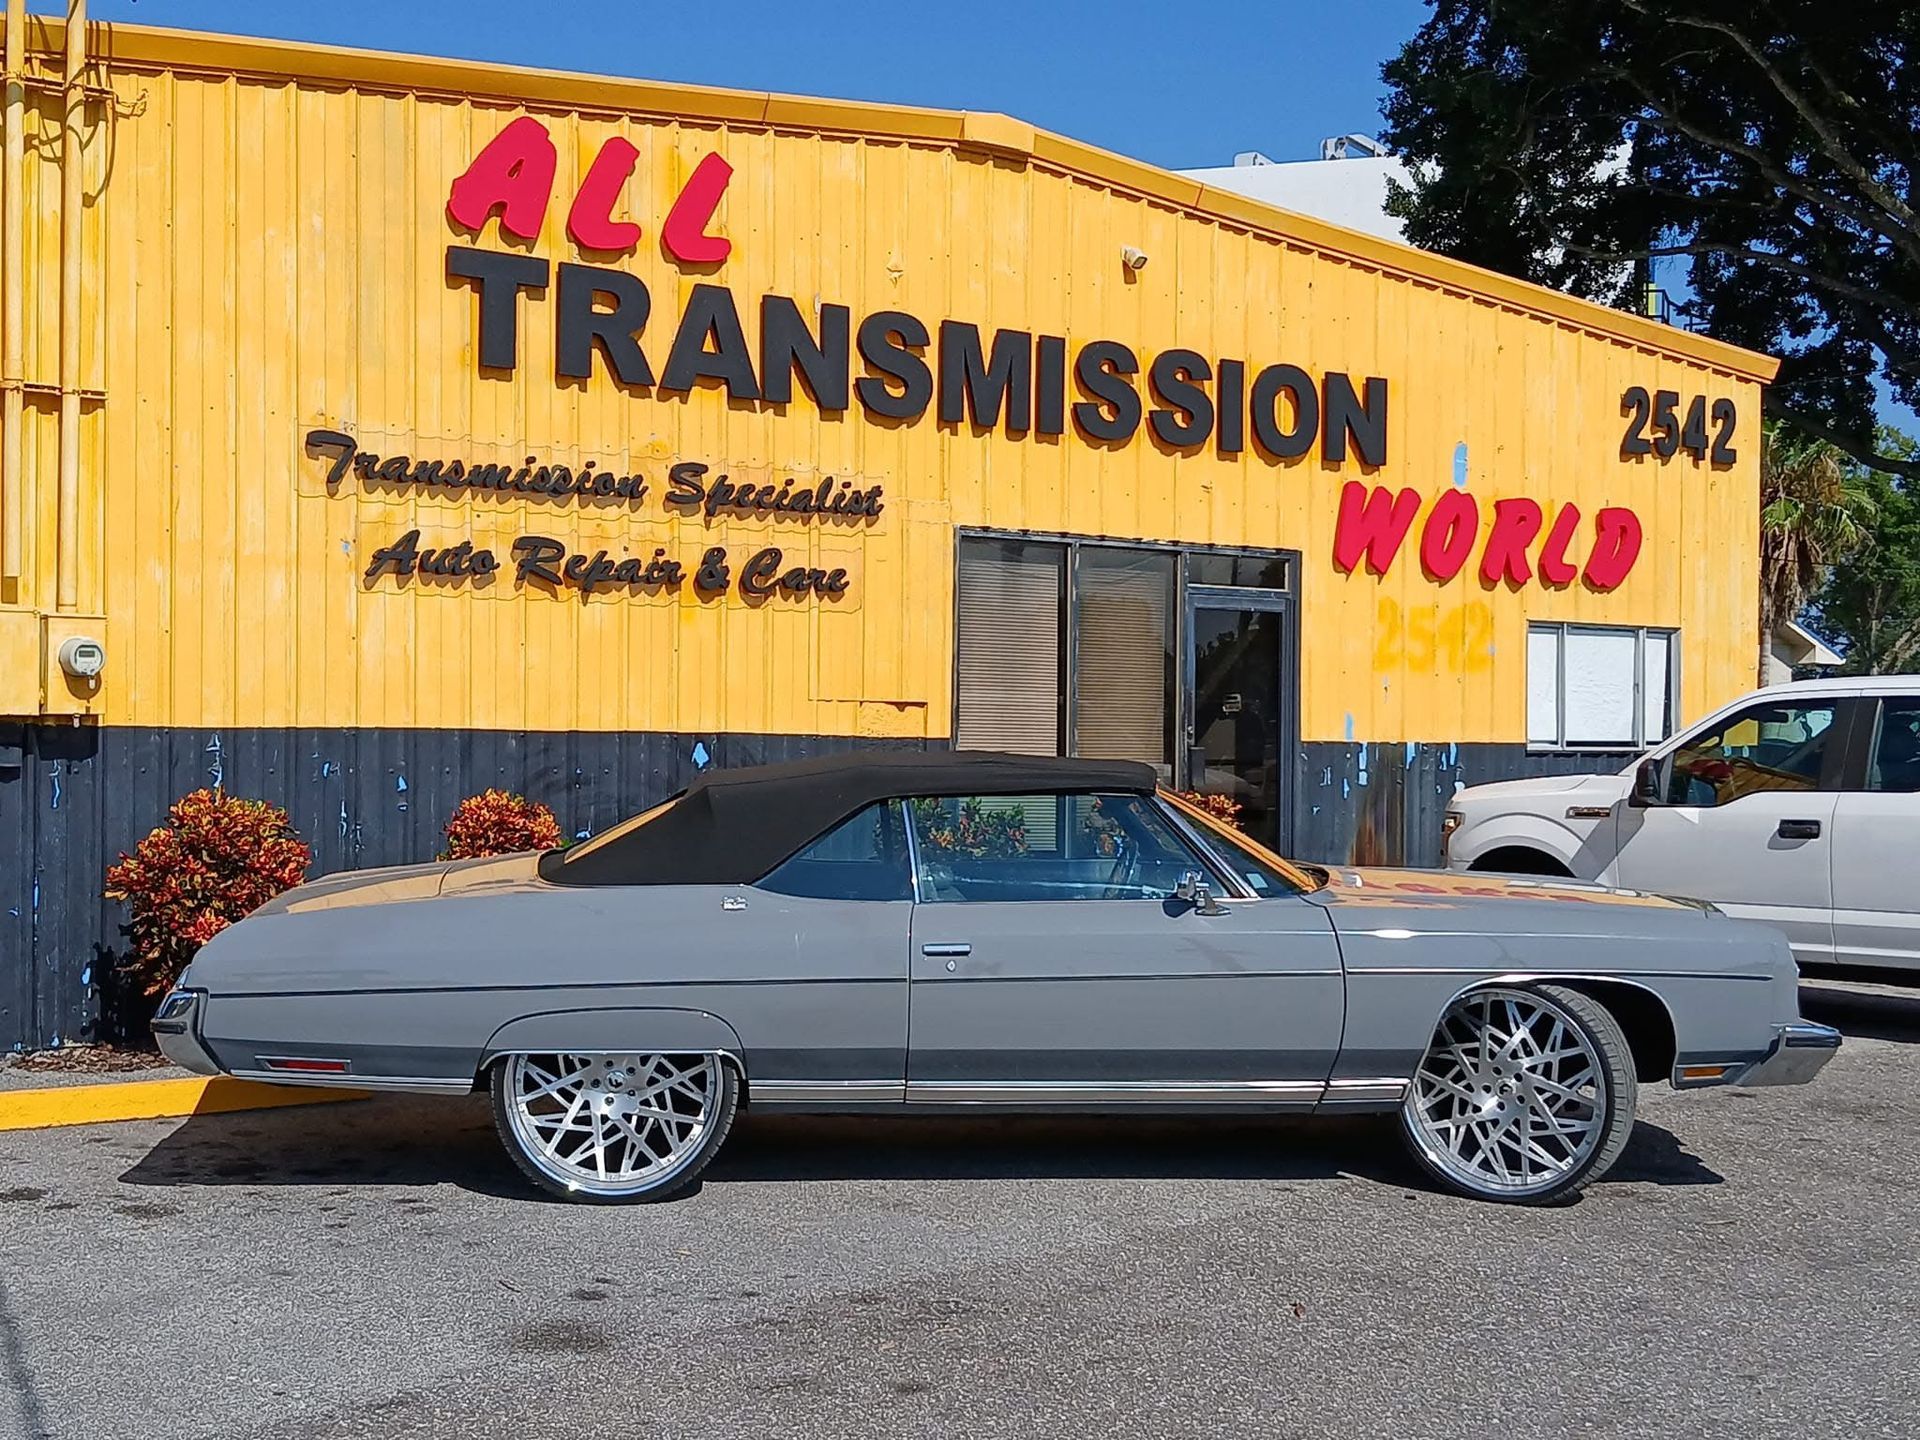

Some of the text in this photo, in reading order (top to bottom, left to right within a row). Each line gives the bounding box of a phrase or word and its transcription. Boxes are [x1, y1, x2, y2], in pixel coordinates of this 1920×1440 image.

[447, 116, 733, 263] ALL
[446, 245, 1388, 467] TRANSMISSION
[1621, 386, 1737, 465] 2542
[305, 429, 884, 519] Transmission Specialist
[364, 529, 850, 594] Auto Repair & Care
[1333, 480, 1643, 589] WORLD
[1373, 596, 1494, 673] 2542
